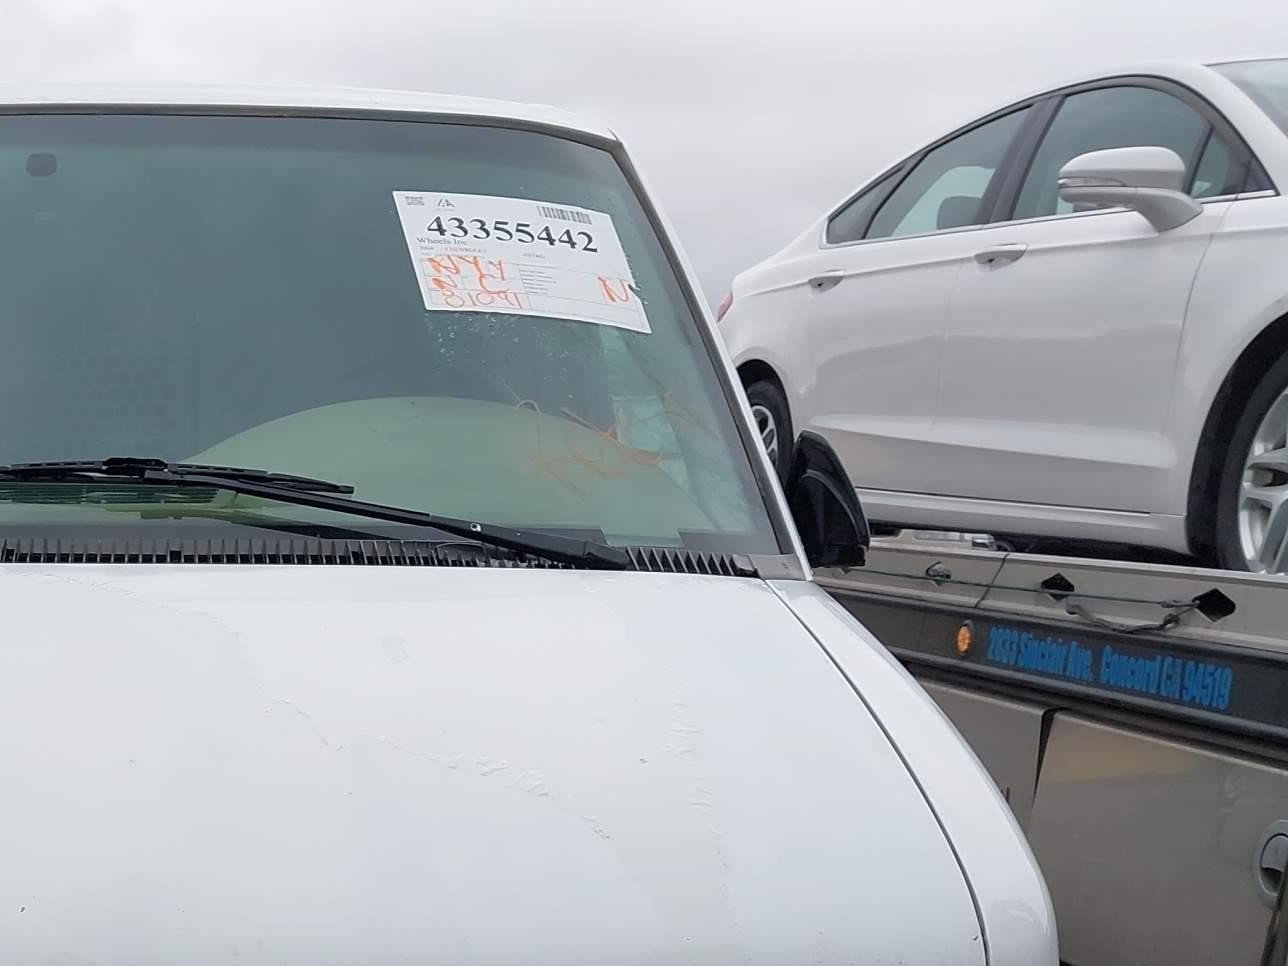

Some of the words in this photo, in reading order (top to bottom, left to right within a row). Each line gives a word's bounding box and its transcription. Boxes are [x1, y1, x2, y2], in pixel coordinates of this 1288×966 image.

[427, 216, 598, 253] 43355442
[1018, 633, 1066, 673] Sinclair
[1102, 646, 1161, 692] Concord
[1161, 657, 1182, 698] CA
[1183, 661, 1232, 709] 94519
